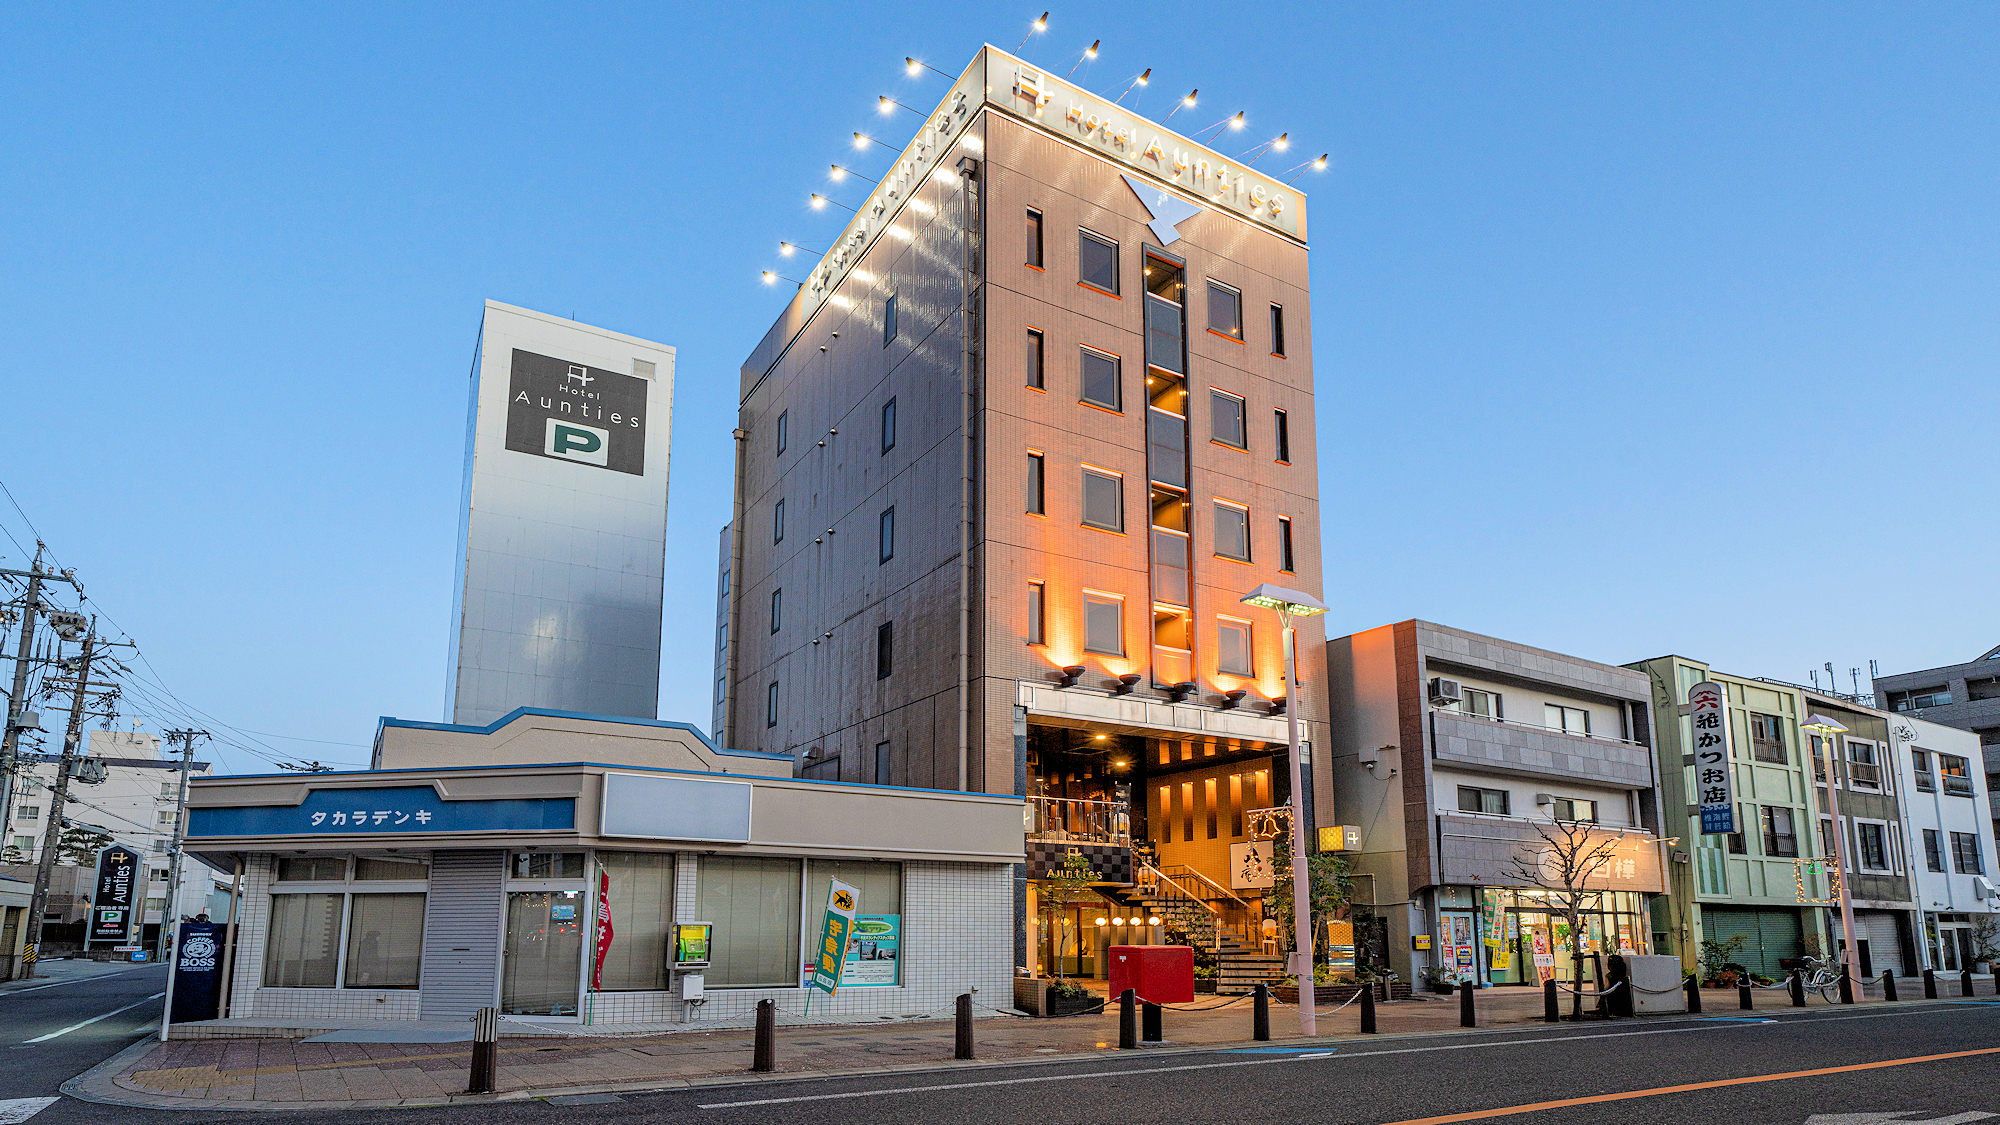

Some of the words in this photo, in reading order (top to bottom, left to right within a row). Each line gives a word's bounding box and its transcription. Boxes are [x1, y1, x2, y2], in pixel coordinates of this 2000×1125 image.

[1068, 98, 1137, 147] Hotel
[1142, 134, 1284, 215] Aunties
[559, 384, 600, 400] Hotel
[515, 390, 639, 428] Aunties
[553, 424, 602, 454] P
[311, 809, 432, 826] タカラデンキ
[102, 876, 111, 893] Hotel
[112, 865, 131, 903] Aunties
[104, 912, 118, 921] P
[180, 957, 215, 967] BOSS
